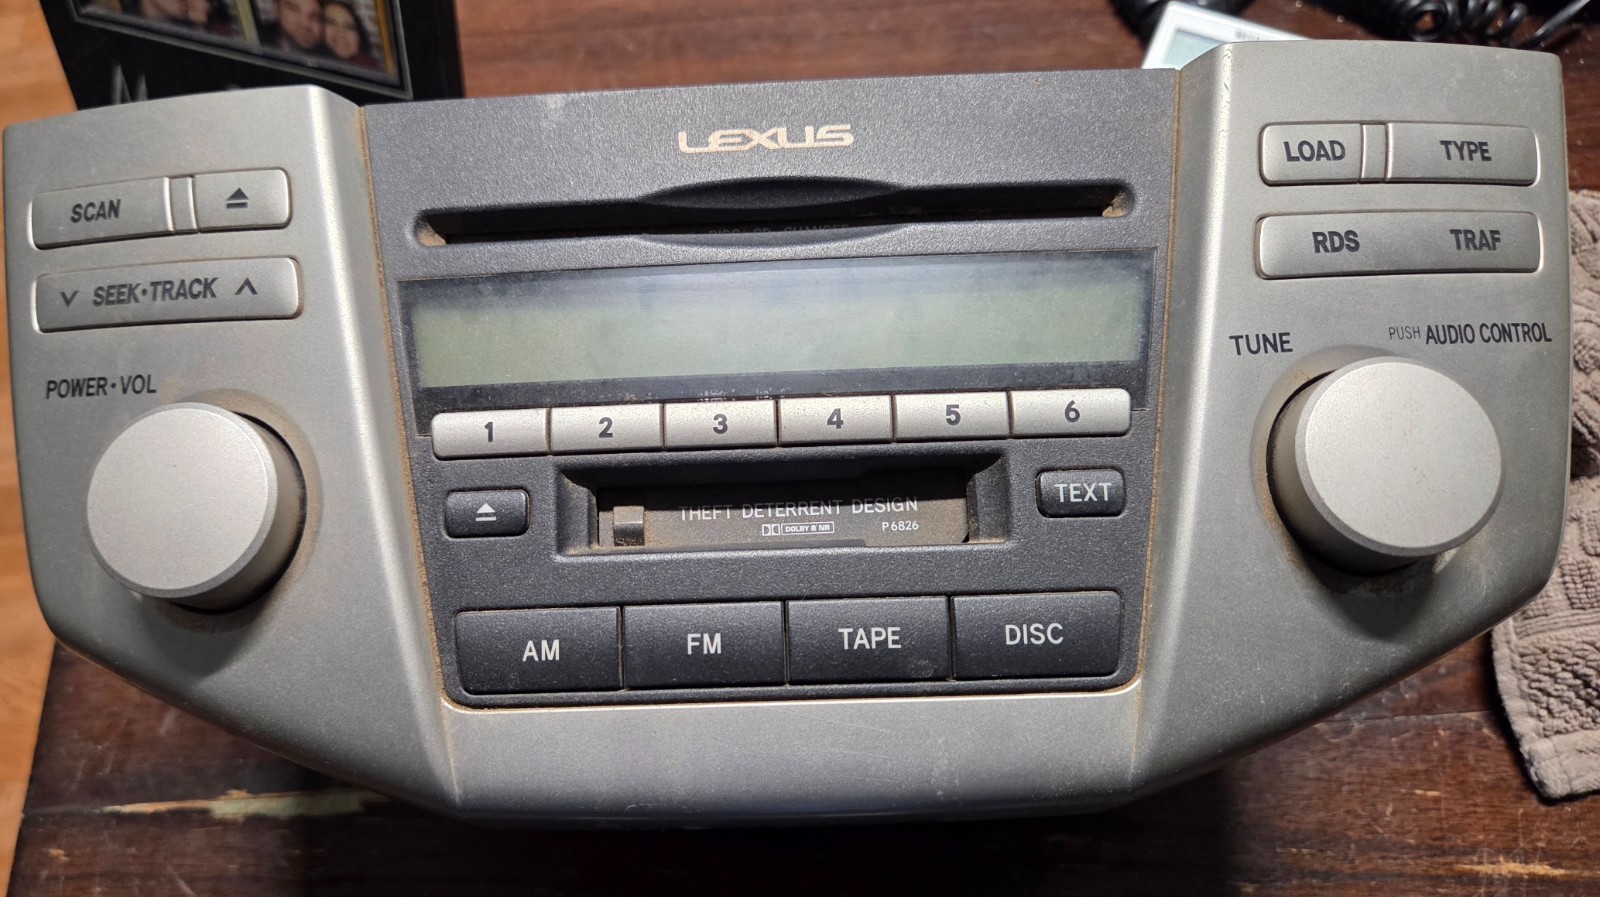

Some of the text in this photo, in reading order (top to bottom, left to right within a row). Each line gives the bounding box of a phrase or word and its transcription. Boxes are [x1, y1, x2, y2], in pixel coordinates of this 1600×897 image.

[678, 123, 853, 153] LEXUS
[1284, 140, 1345, 162] LOAD
[1440, 140, 1491, 161] TYPE
[71, 199, 120, 223] SCAN
[1312, 230, 1360, 253] RDS
[1449, 229, 1501, 250] TRAF
[1229, 332, 1293, 355] TUNE
[1389, 323, 1552, 344] PUSH AUDIO CONTROL
[827, 408, 843, 429] 4
[946, 404, 960, 426] 5
[1065, 400, 1080, 422] 6
[485, 422, 493, 442] 1
[599, 417, 613, 438] 2
[713, 414, 728, 434] 3
[1054, 482, 1111, 502] TEXT
[678, 496, 918, 521] THEFT DETERRENT DESIGN
[882, 521, 919, 532] P6826
[688, 633, 721, 654] FM
[838, 627, 901, 649] TAPE
[1005, 623, 1063, 645] DISC
[523, 639, 559, 661] AM
